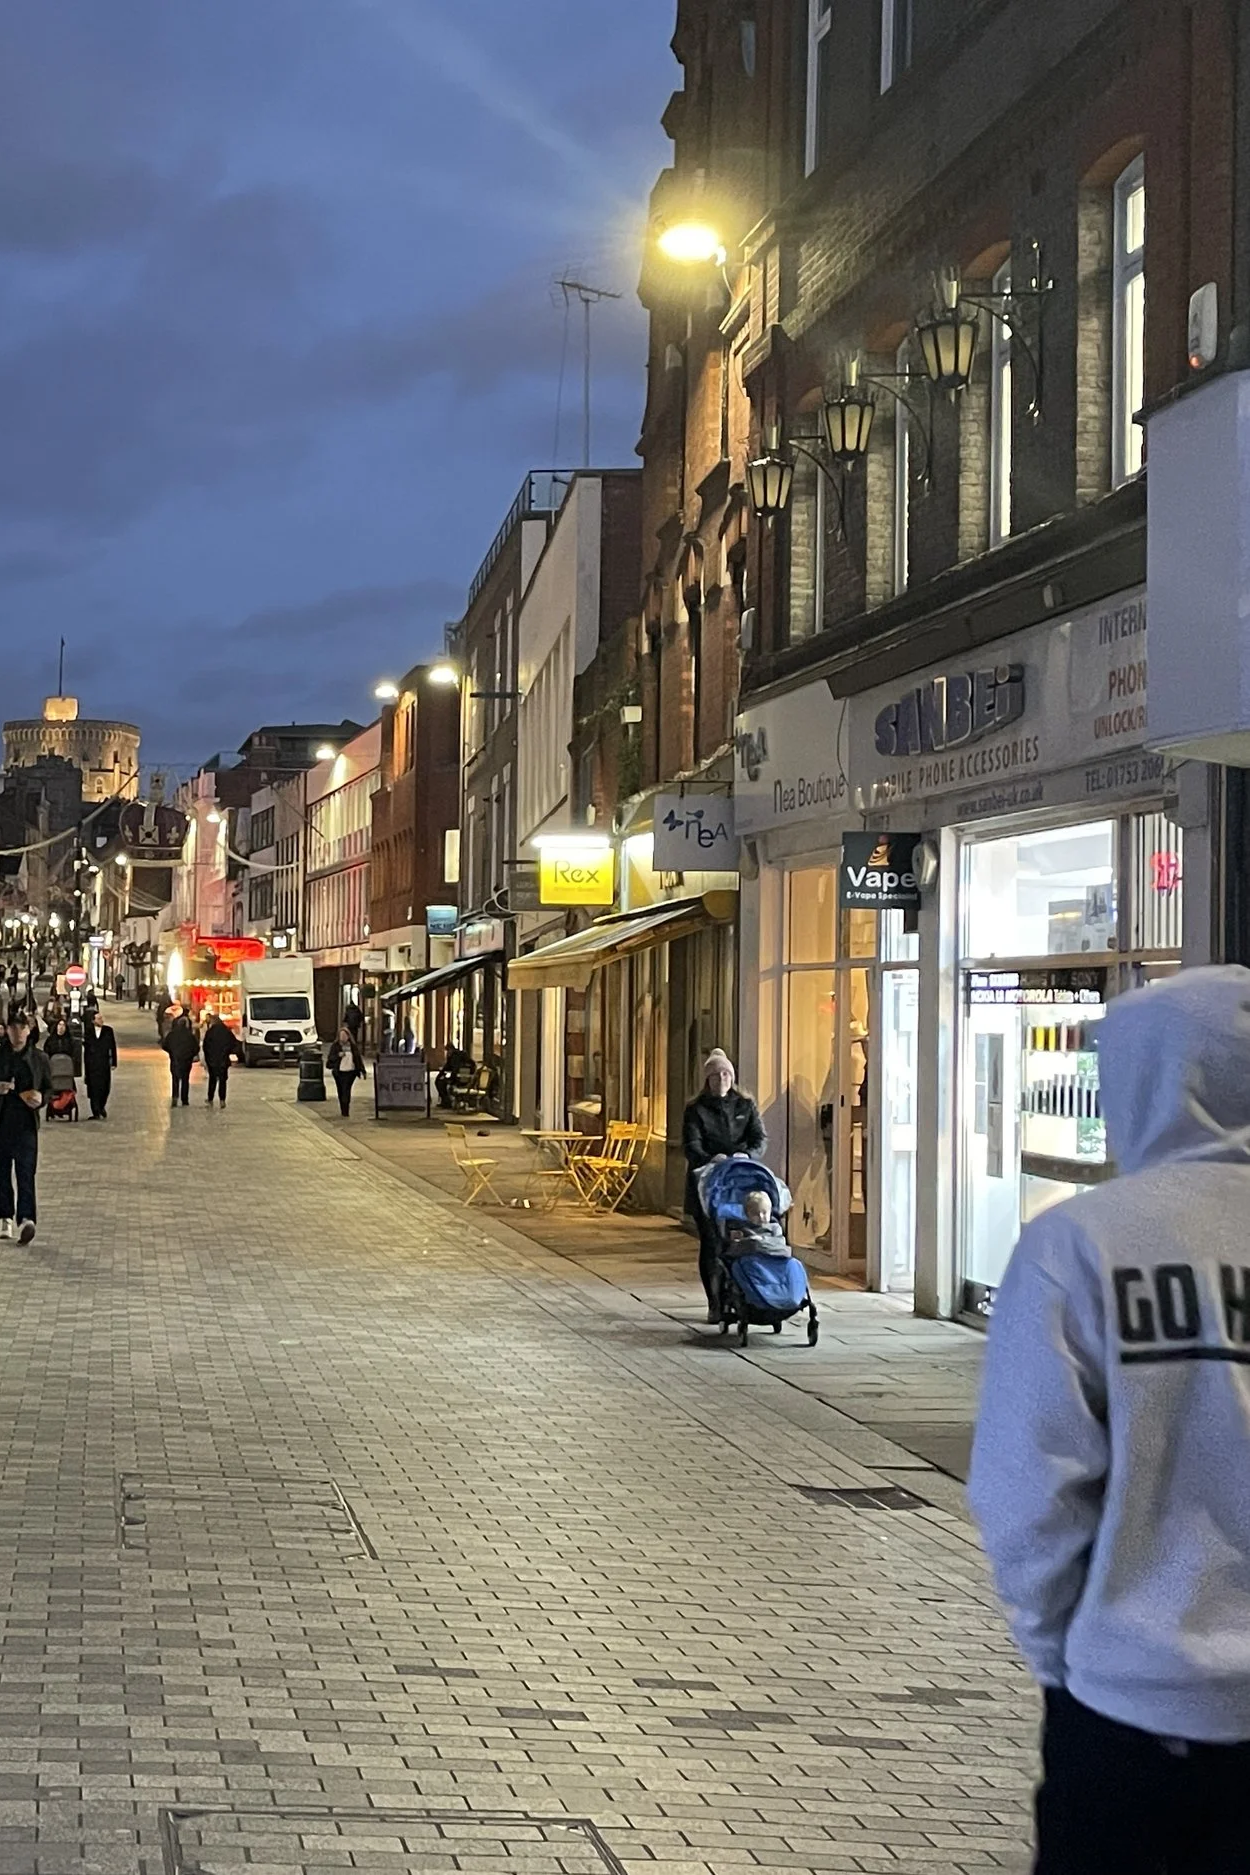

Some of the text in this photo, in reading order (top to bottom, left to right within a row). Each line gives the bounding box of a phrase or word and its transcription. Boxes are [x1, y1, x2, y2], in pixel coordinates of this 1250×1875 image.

[918, 760, 955, 789] PHONE
[958, 735, 1040, 781] ACCESSORIES
[798, 773, 846, 808] Boutique
[554, 860, 600, 883] Rex
[846, 866, 916, 892] Vape
[1113, 1263, 1202, 1343] GO
